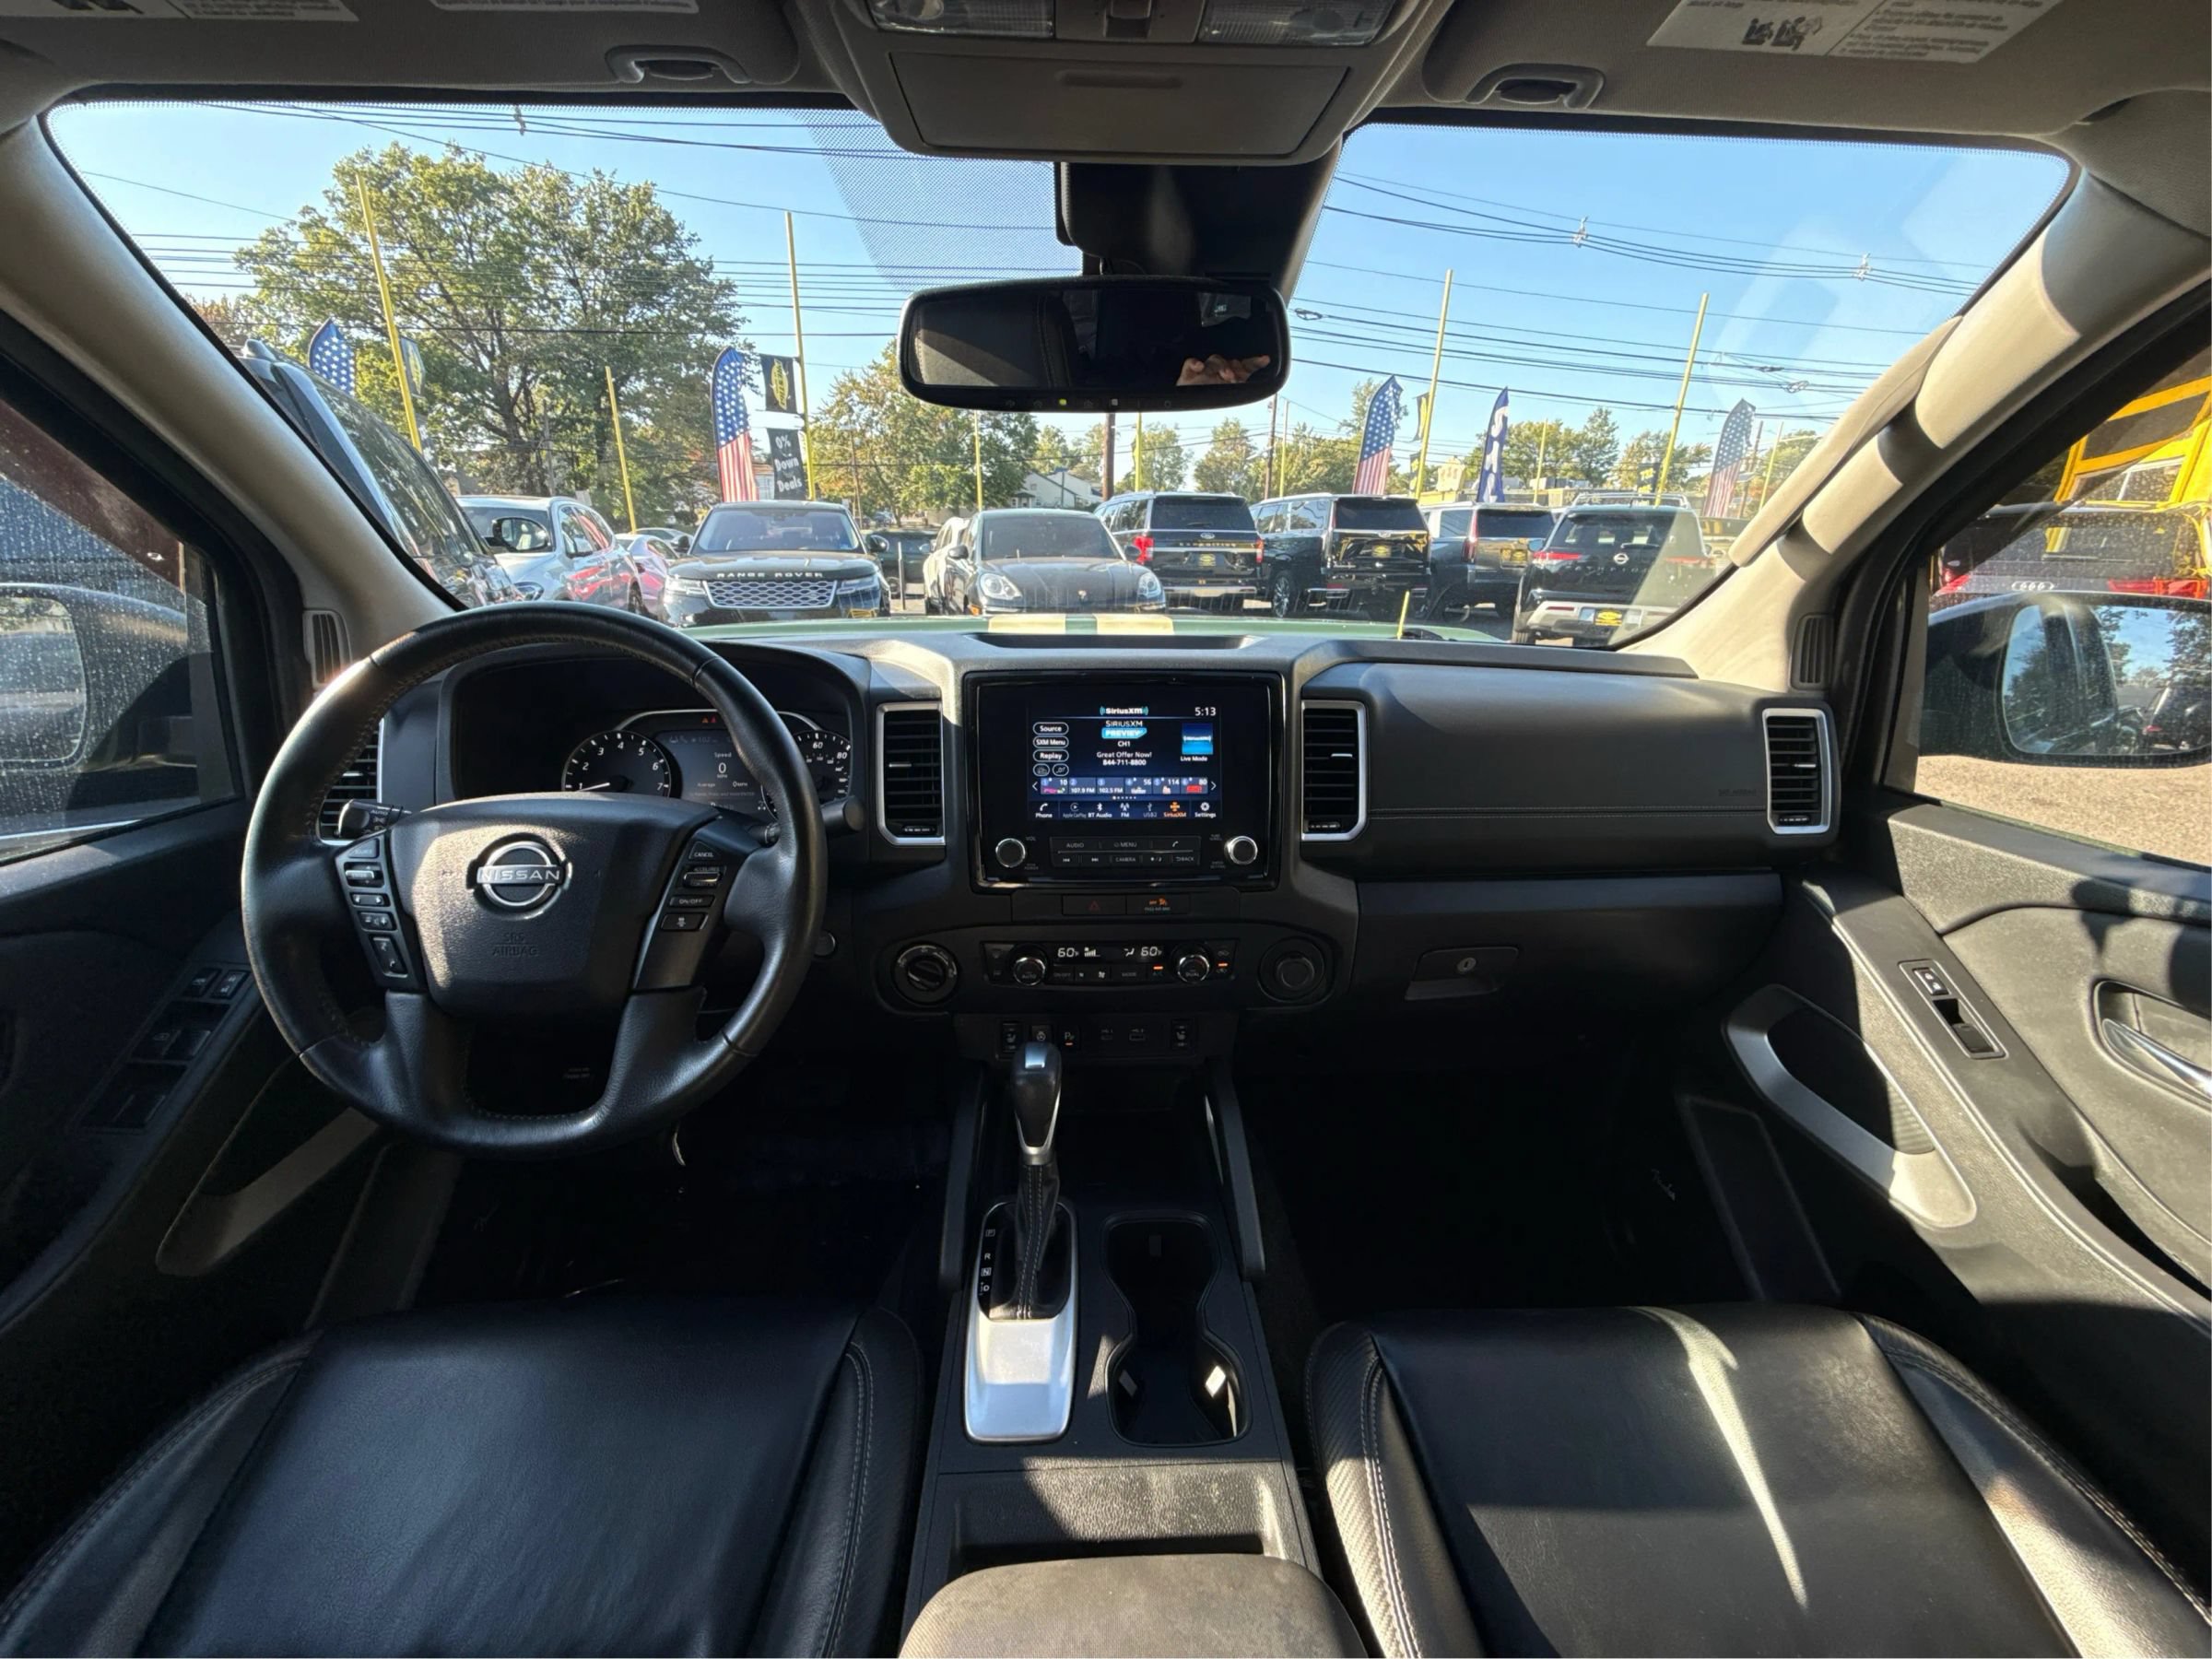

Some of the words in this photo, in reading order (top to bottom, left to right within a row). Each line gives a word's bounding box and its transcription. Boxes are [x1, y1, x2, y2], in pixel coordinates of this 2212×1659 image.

[775, 434, 792, 449] 0%
[774, 457, 799, 472] Down
[777, 477, 802, 492] Deals
[1194, 707, 1217, 716] 5:13
[618, 741, 624, 749] 4
[597, 747, 605, 756] 3
[638, 747, 645, 756] 5
[1040, 752, 1063, 760] Replay
[582, 762, 590, 771] 2
[652, 762, 659, 771] 6
[719, 762, 726, 773] 0
[657, 782, 664, 791] 7
[480, 869, 559, 880] NISSAN
[492, 946, 538, 957] AIRBAG
